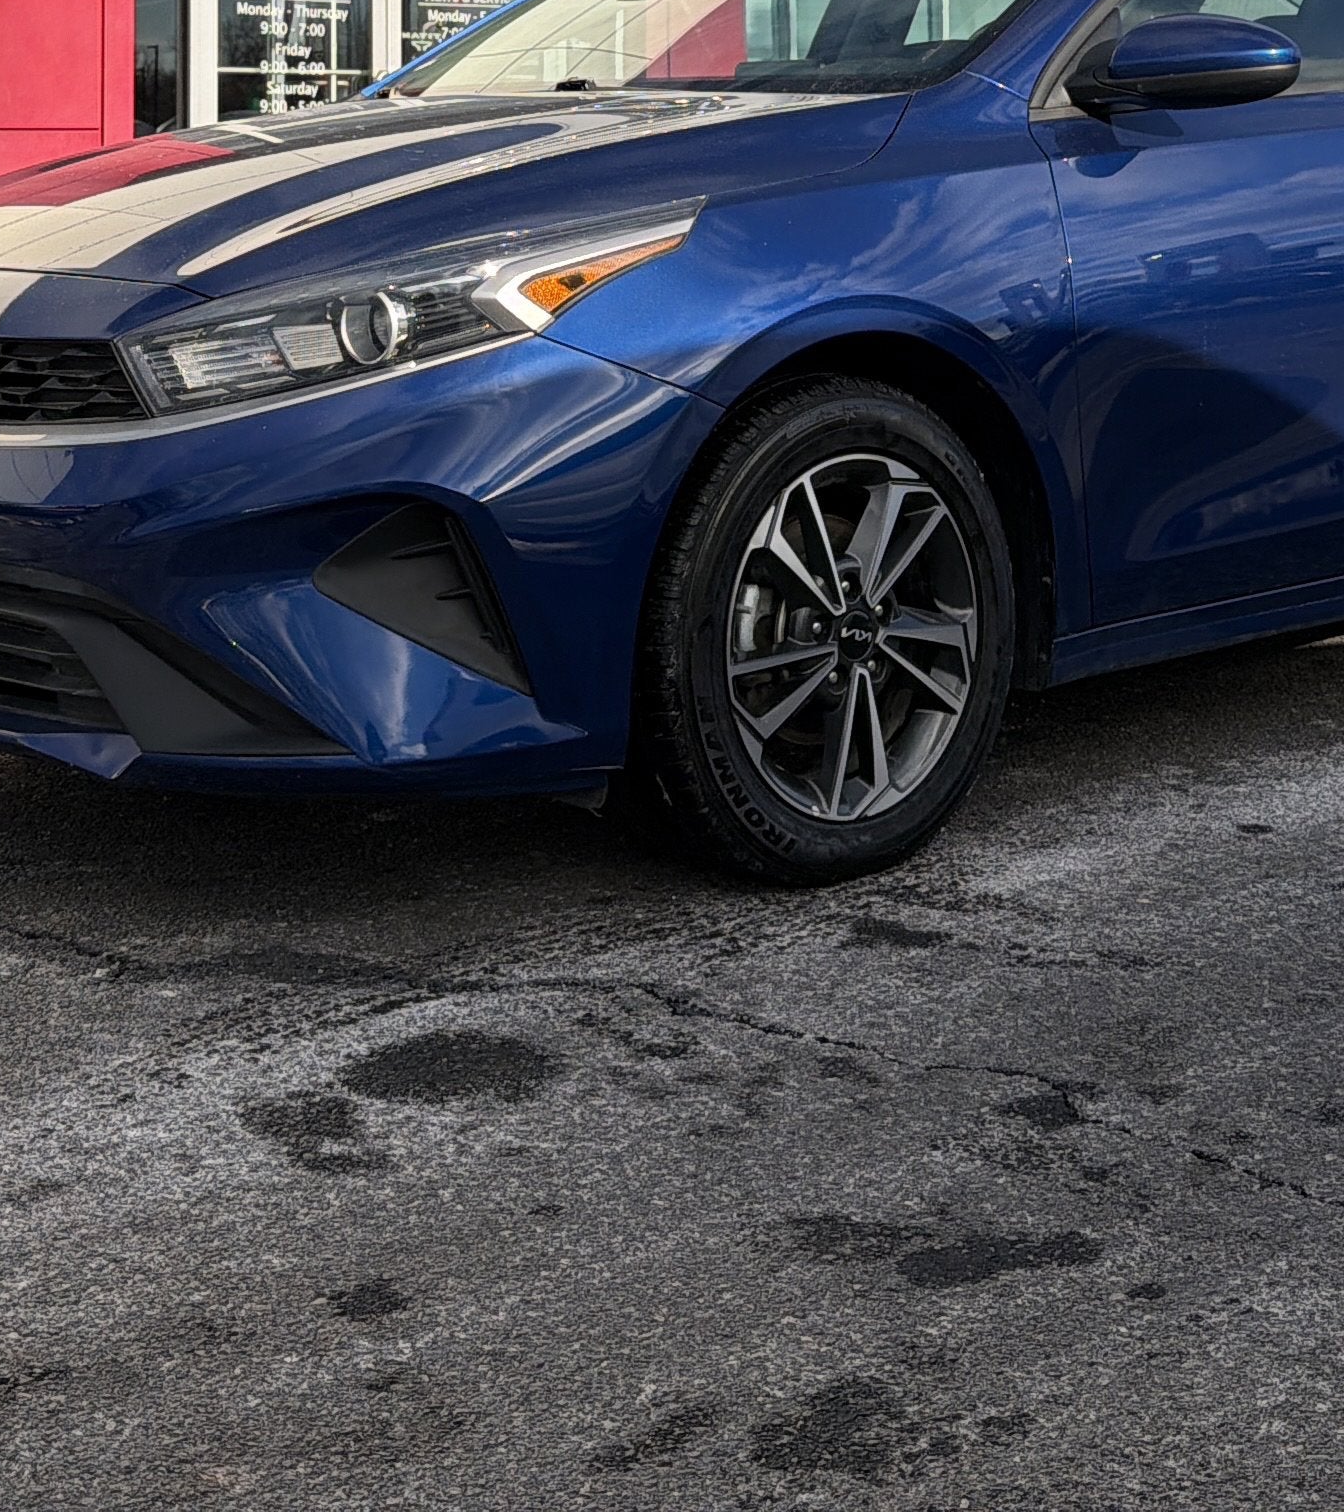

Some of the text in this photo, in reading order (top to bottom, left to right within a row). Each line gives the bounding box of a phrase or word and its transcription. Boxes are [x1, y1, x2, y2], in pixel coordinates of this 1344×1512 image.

[236, 1, 285, 20] Monday
[294, 3, 349, 22] Thursday
[427, 9, 471, 25] Monday
[260, 21, 288, 36] 9:00
[298, 23, 326, 37] 7:00
[275, 42, 312, 59] Friday
[260, 60, 288, 74] 9:00
[298, 61, 326, 75] 6:00
[266, 81, 319, 97] Saturday
[259, 99, 288, 114] 9:00
